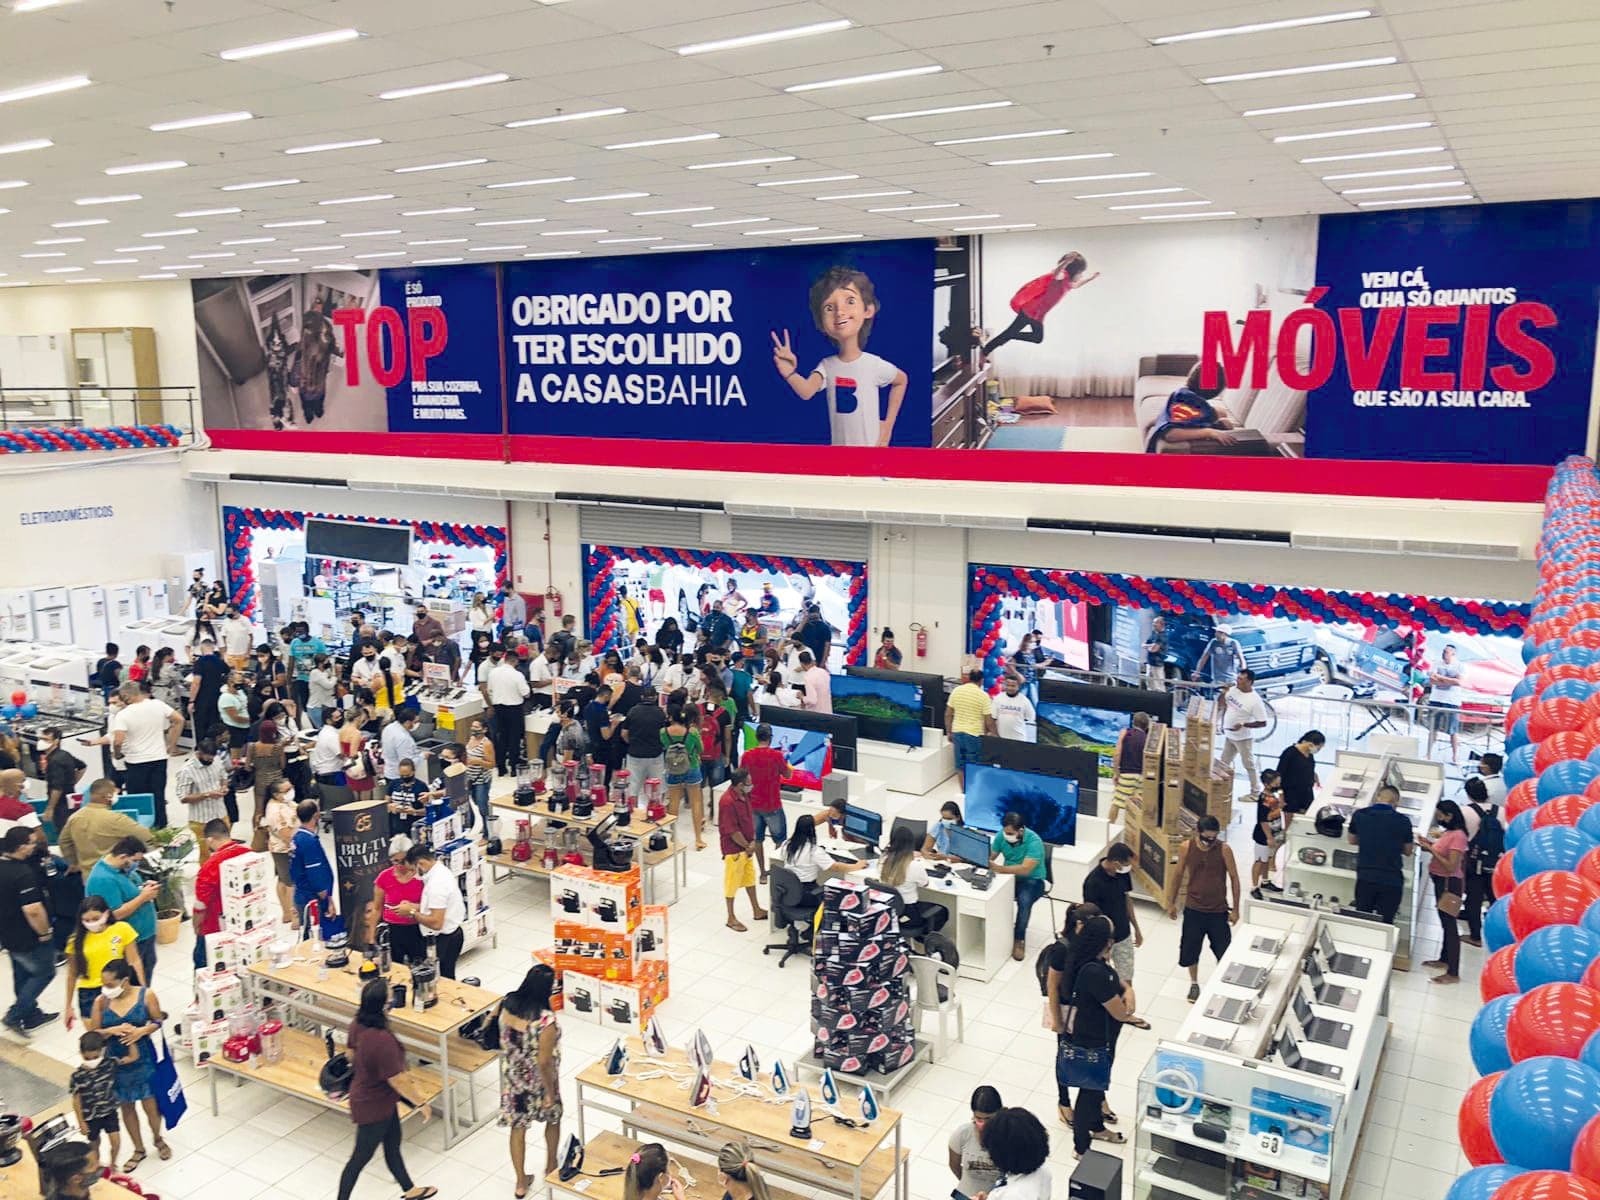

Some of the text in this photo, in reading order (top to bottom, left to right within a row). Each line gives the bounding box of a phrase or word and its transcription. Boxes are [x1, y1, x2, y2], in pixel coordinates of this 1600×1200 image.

[1361, 266, 1429, 288] VEM CÁ,
[512, 289, 734, 327] OBRIGADO POR
[1360, 286, 1517, 308] OLHA SÓ QUANTOS
[332, 305, 448, 389] TOP
[512, 331, 743, 366] TER ESCOLHIDO
[1200, 286, 1558, 392] MÓVEIS
[515, 373, 538, 403] A
[1353, 386, 1532, 408] QUE SÃO A SUA CARA.
[20, 504, 114, 526] ELETRODOMÉSTICOS
